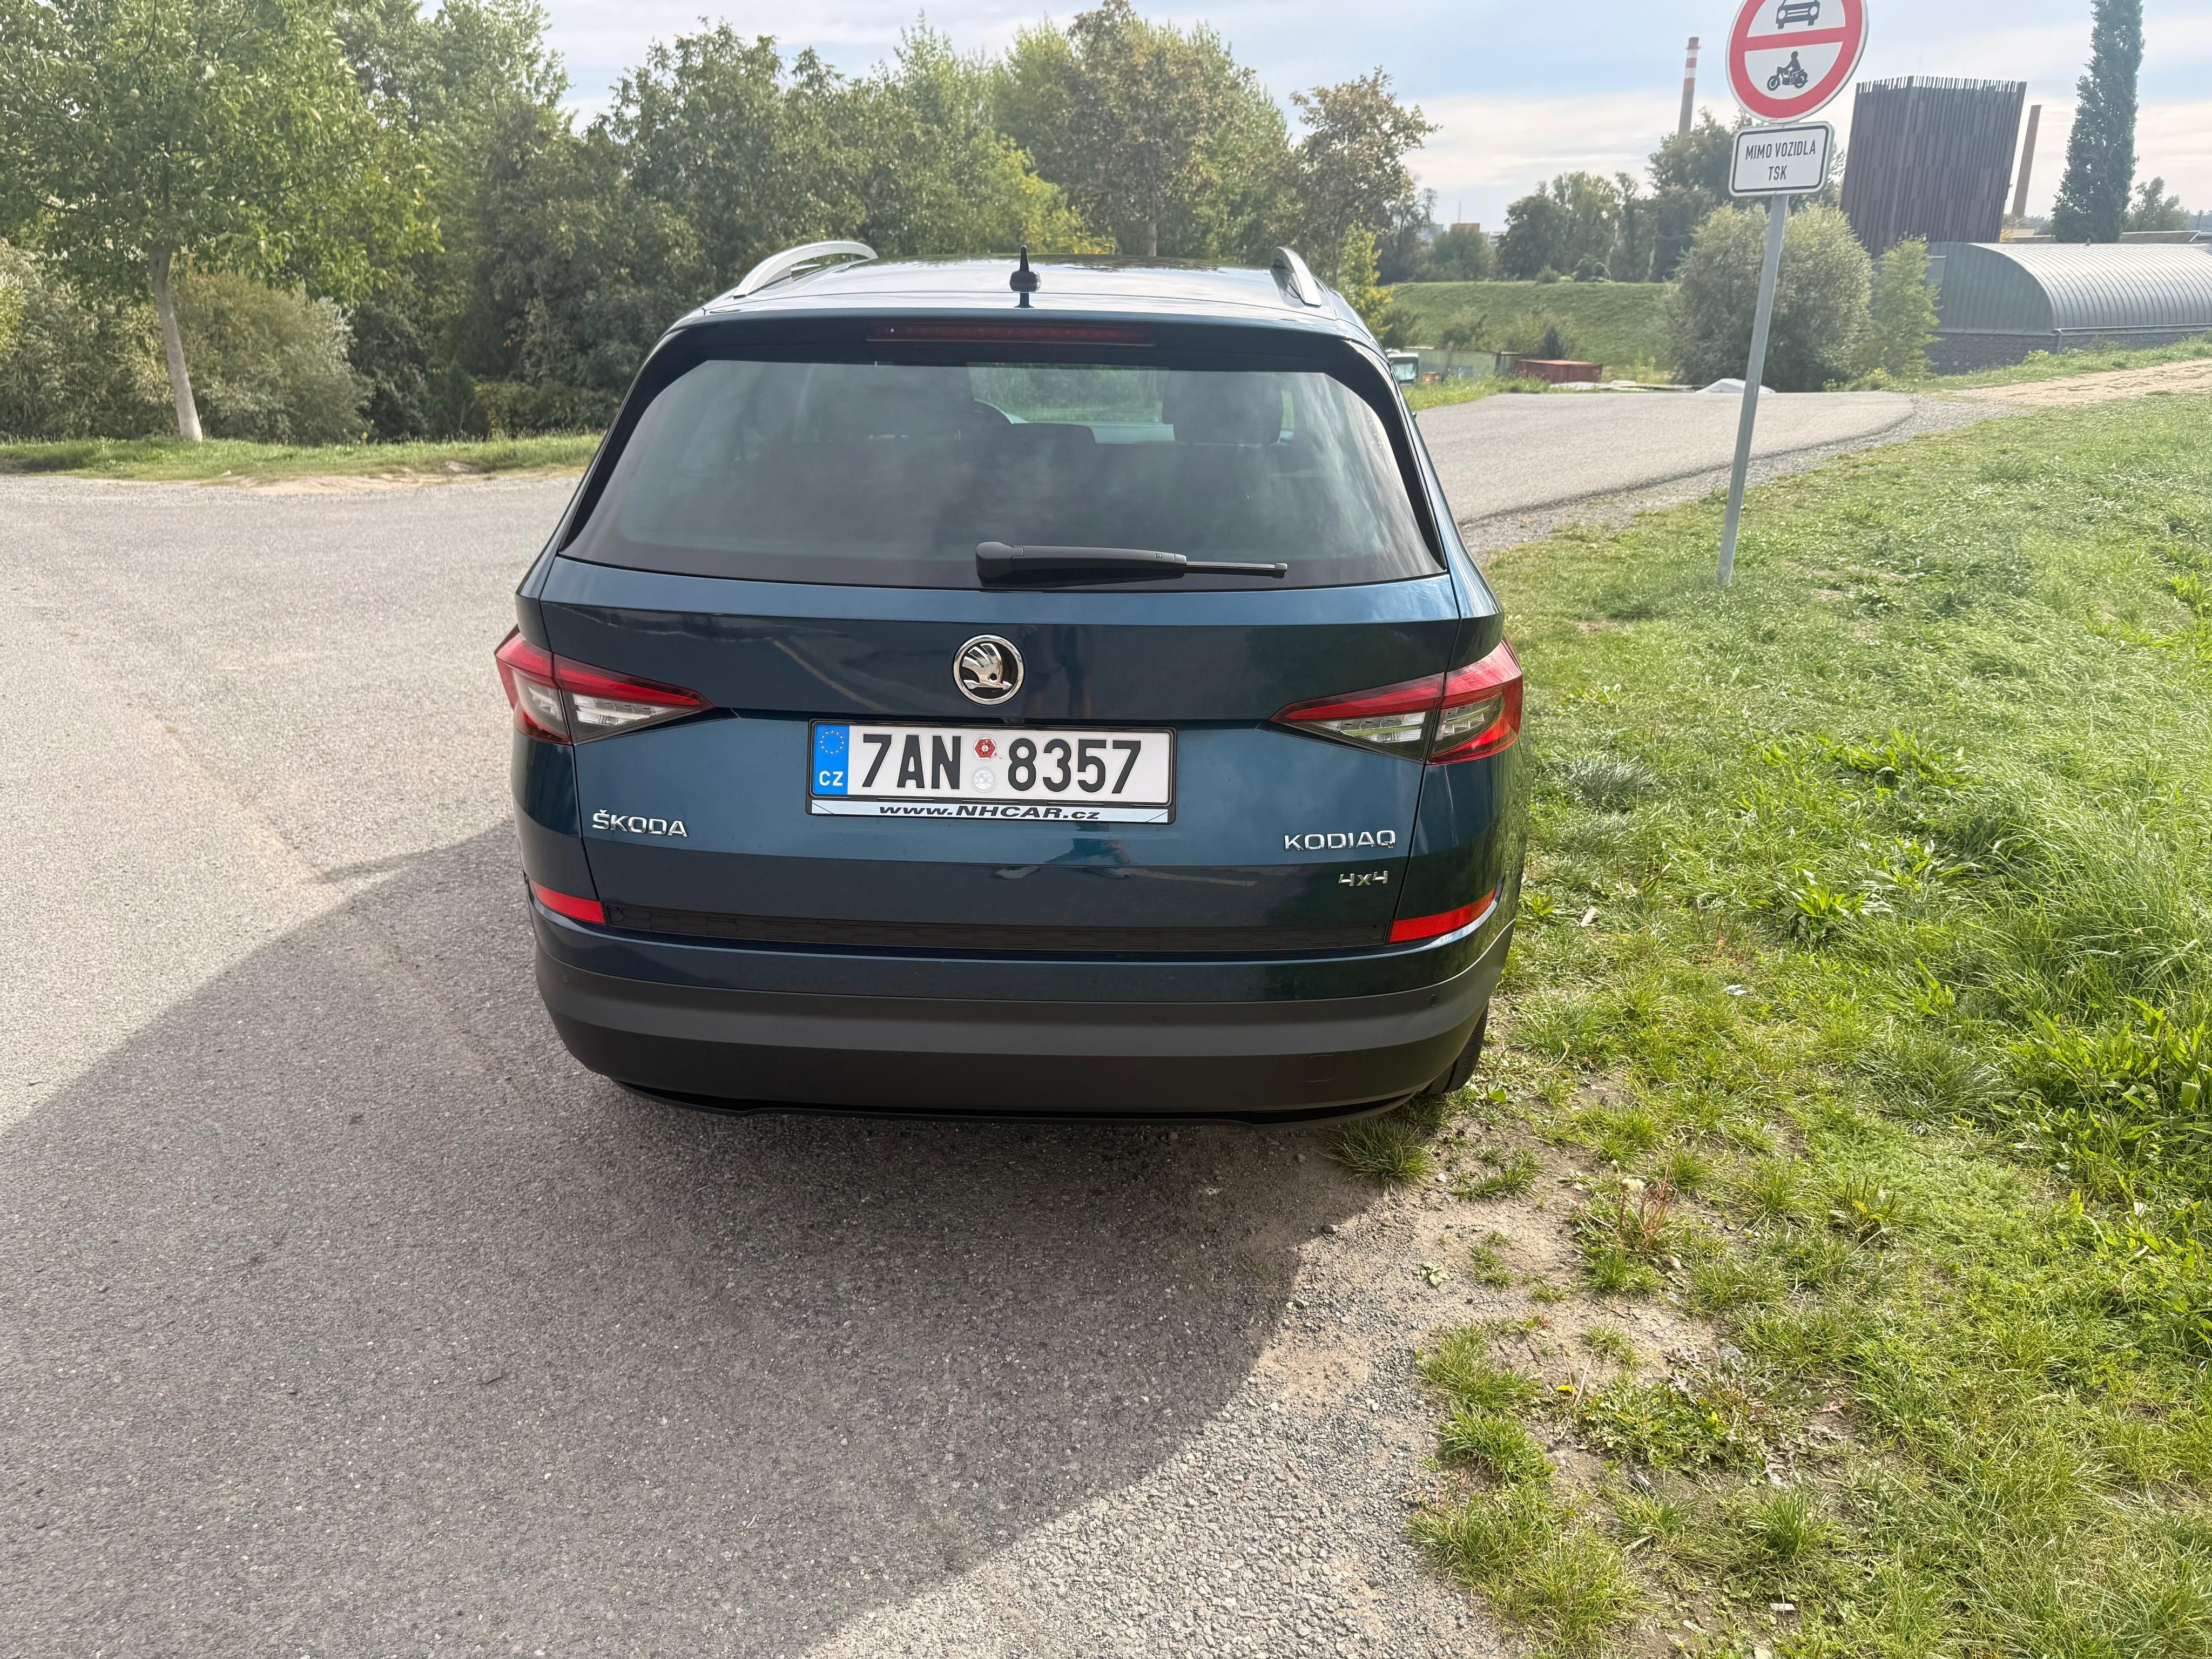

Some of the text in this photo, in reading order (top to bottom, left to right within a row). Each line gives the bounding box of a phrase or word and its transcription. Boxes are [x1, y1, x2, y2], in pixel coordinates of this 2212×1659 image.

[1745, 140, 1816, 160] MIMO VOZIDLA
[1768, 165, 1788, 181] TSK
[862, 733, 1141, 794] 7AN 8357
[819, 771, 844, 786] CZ
[879, 805, 1100, 820] www.NHCAR.cz
[592, 810, 687, 837] ŠKODA
[1284, 830, 1396, 852] KODIAQ
[1338, 870, 1388, 887] 4x4
